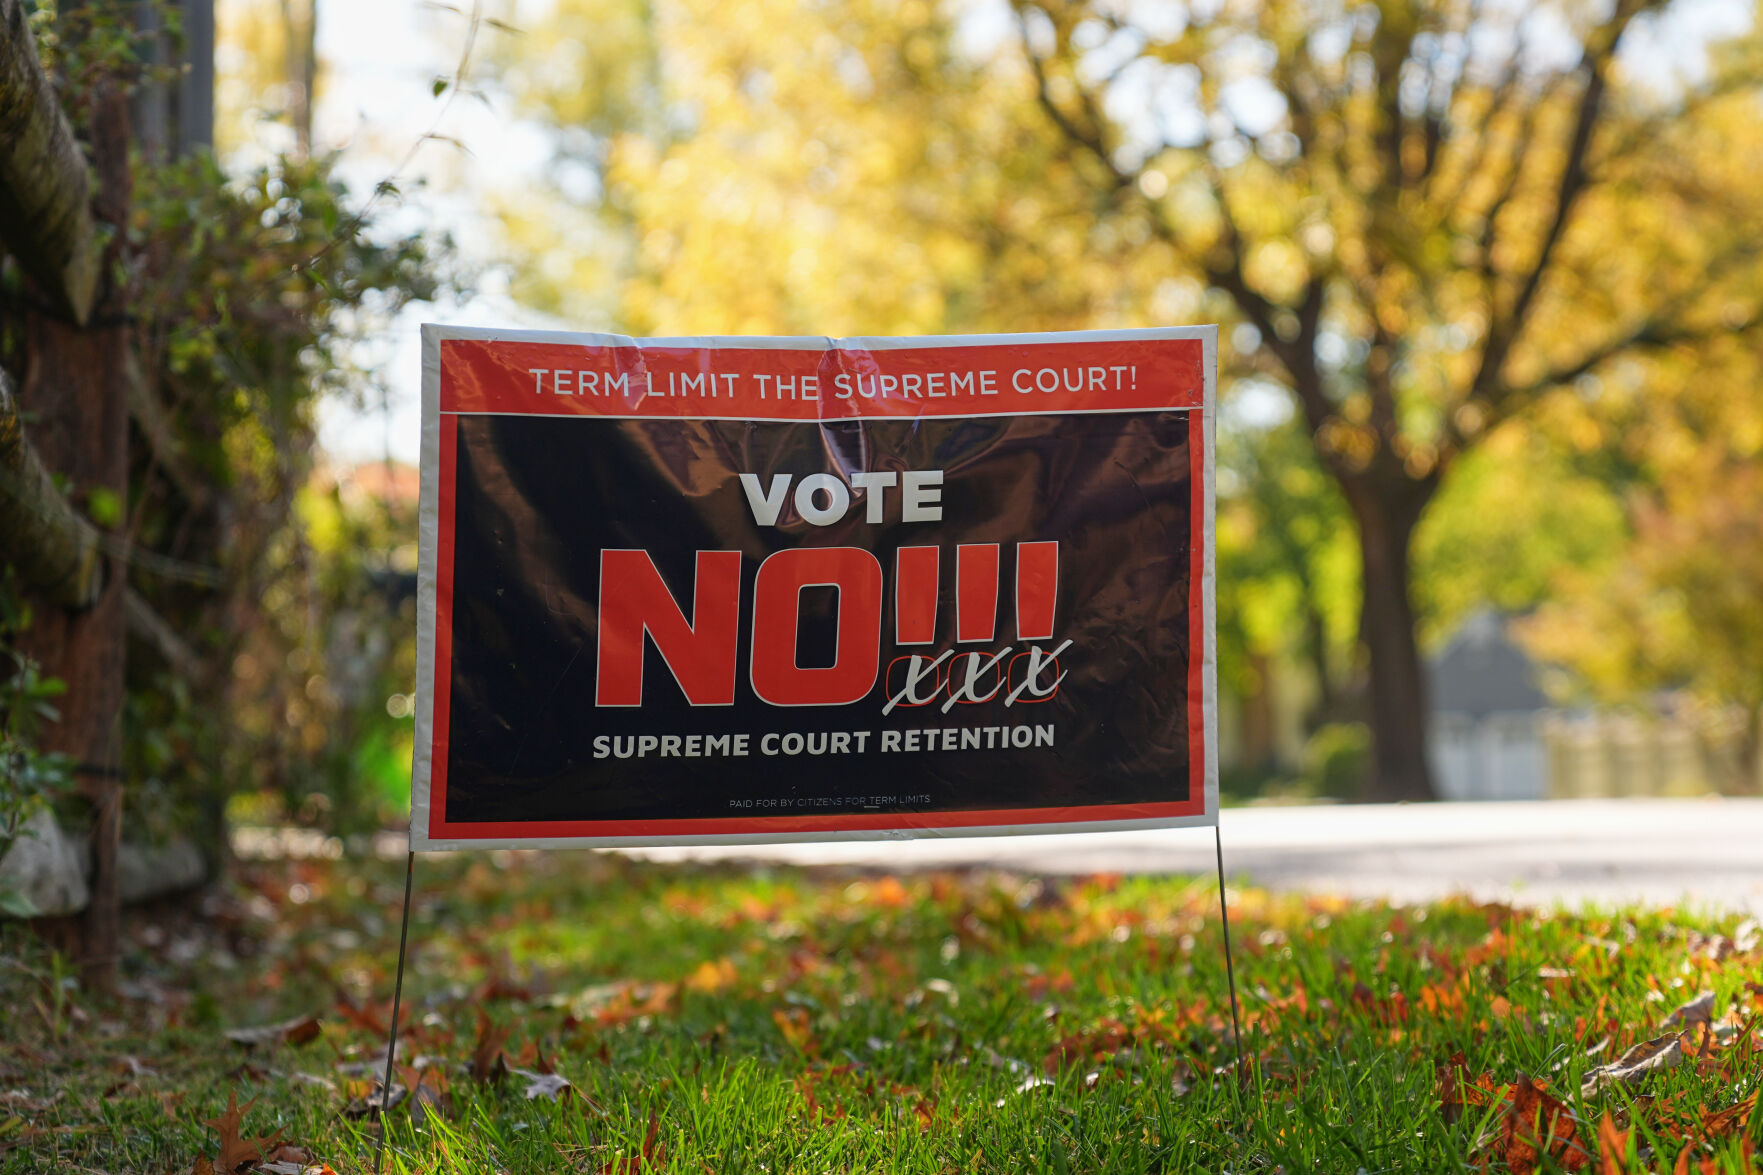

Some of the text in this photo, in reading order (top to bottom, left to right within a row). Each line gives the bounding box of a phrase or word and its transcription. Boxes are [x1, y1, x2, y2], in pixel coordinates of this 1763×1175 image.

[528, 366, 1137, 401] TERM LIMIT THE SUPREME COURT!
[739, 470, 944, 526] VOTE
[593, 724, 1055, 759] SUPREME COURT RETENTION
[729, 794, 931, 808] PAID FOR BY CITIZENS FOR TERM LIMITS
